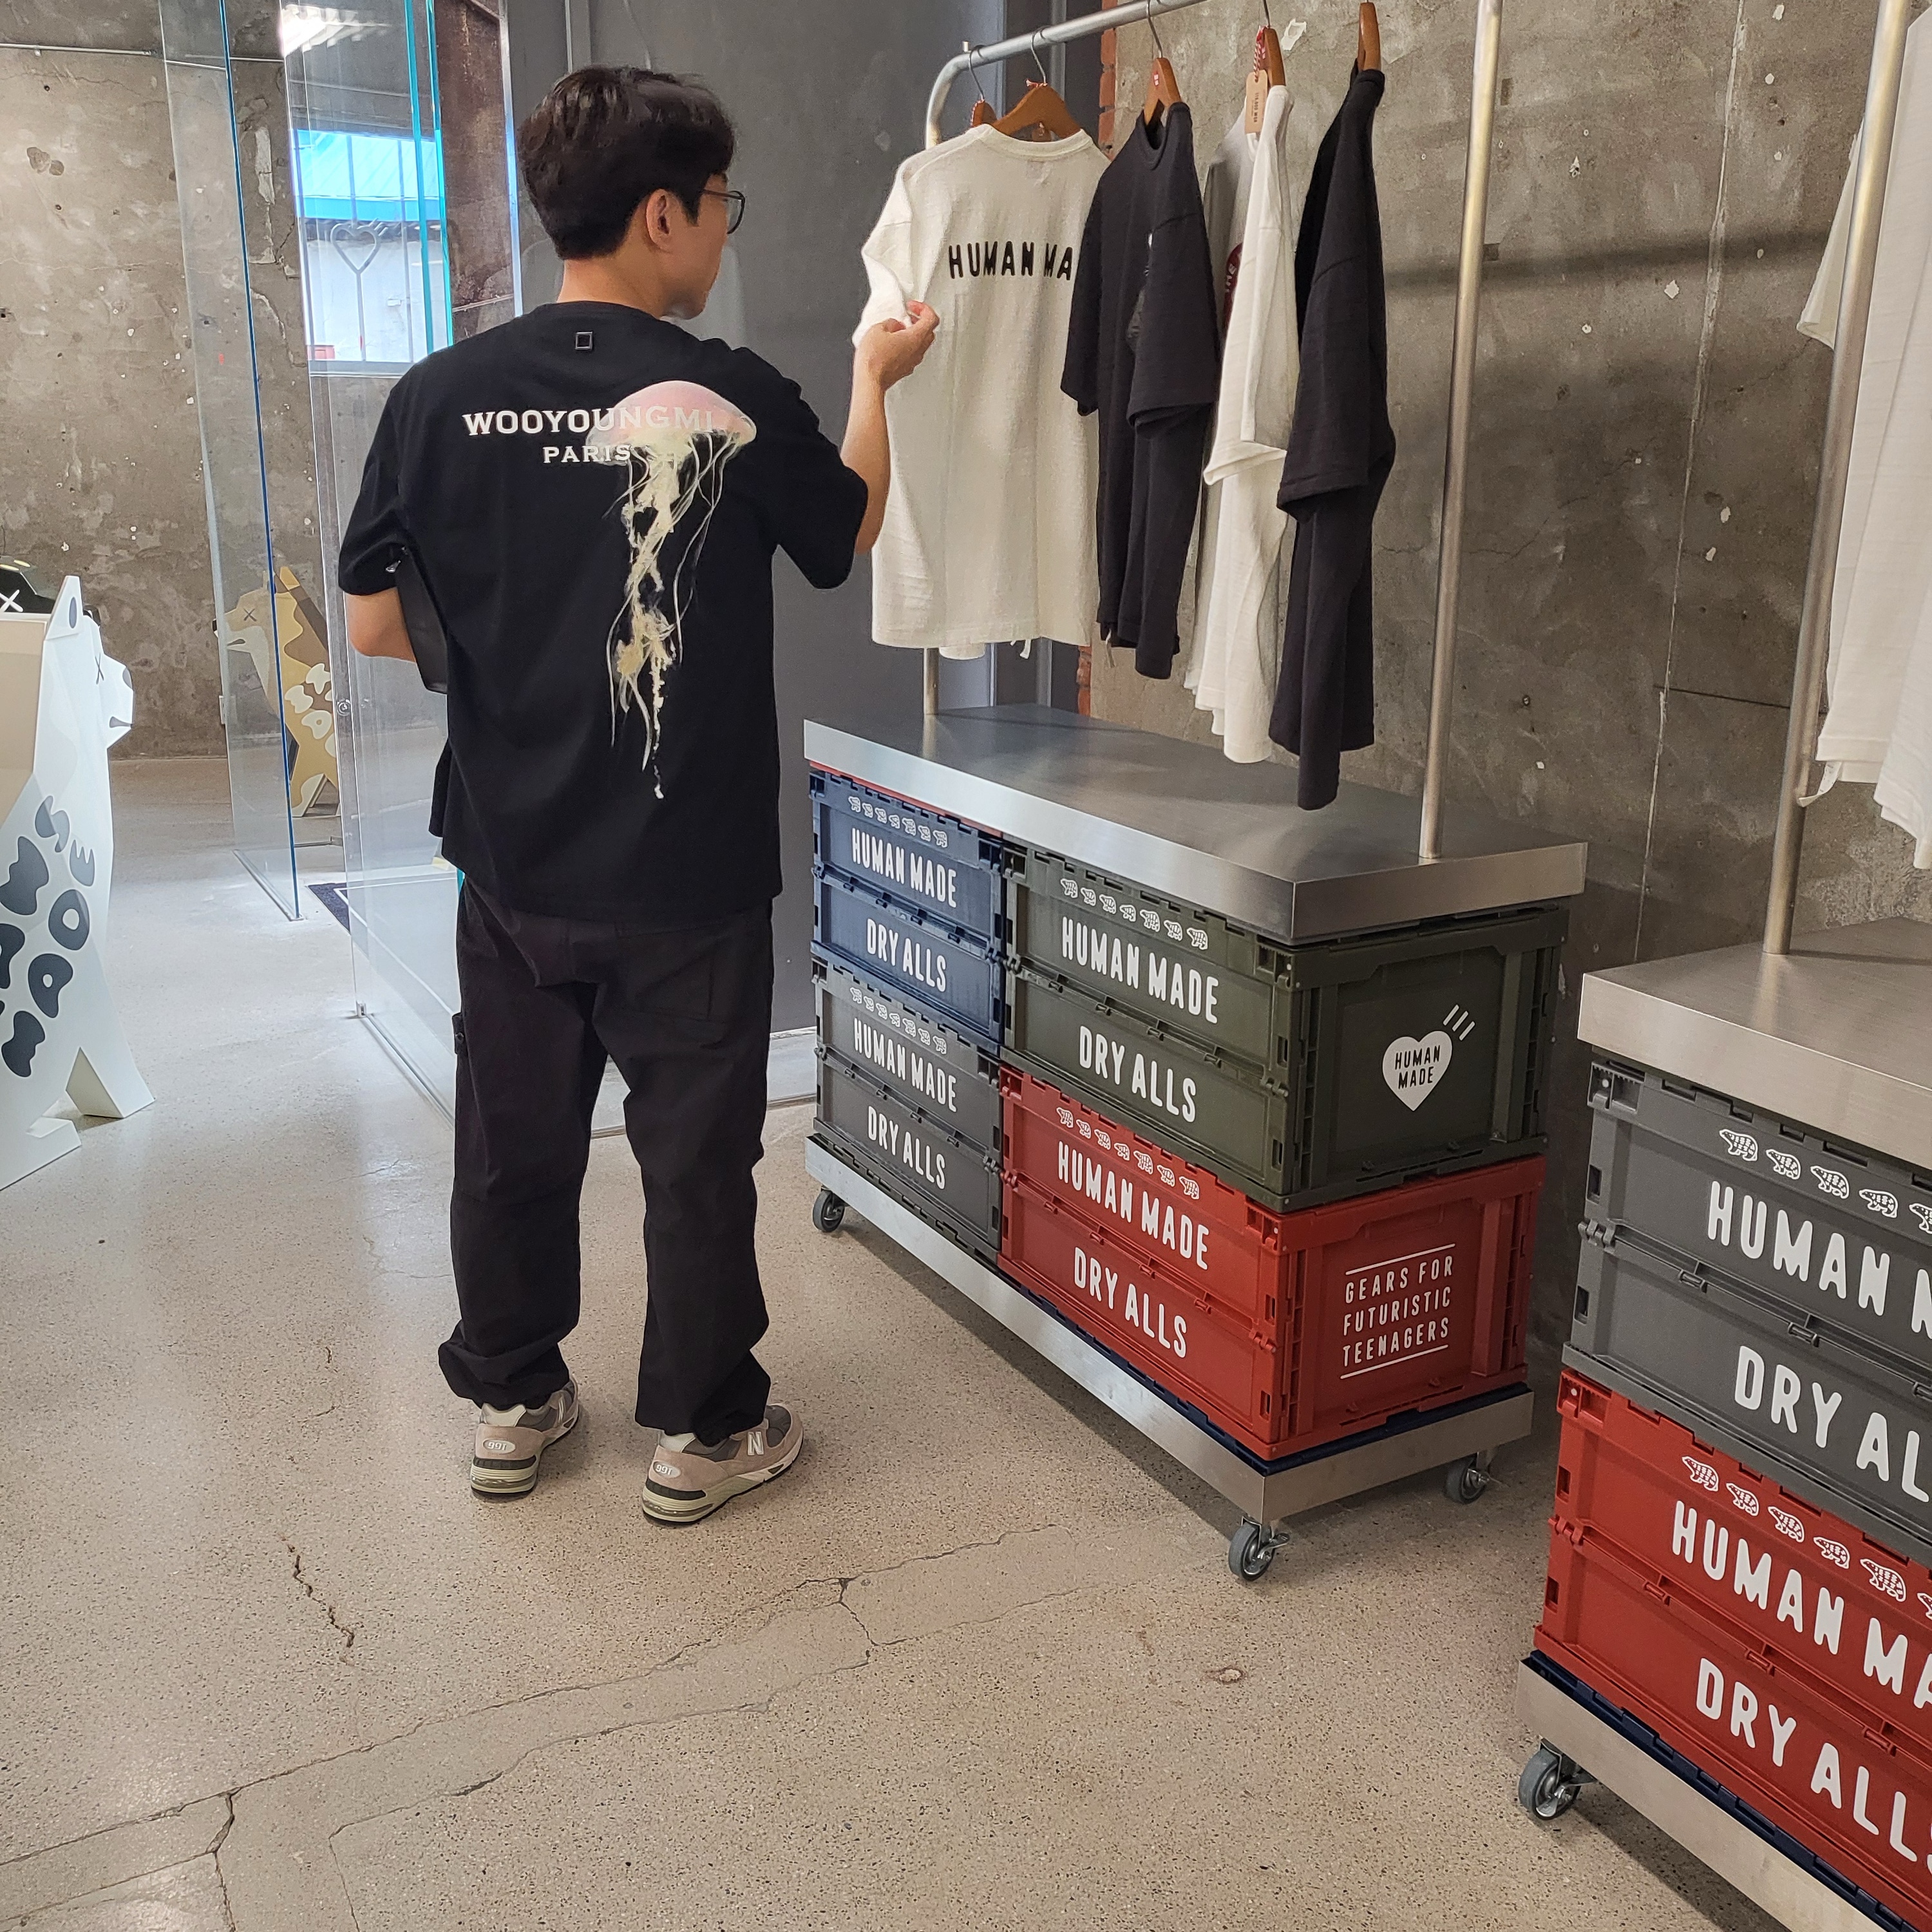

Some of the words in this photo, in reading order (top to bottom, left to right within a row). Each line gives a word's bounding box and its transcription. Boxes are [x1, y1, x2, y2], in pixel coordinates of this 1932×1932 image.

[949, 241, 1034, 279] HUMAN
[462, 405, 714, 436] WOOYOUNGMI
[543, 444, 631, 464] PARIS
[852, 828, 904, 884] HUMAN
[911, 853, 957, 908] MADE
[867, 918, 898, 967] DRY
[903, 938, 946, 992] ALLS
[1063, 917, 1139, 989] HUMAN
[1149, 953, 1218, 1024] MADE
[853, 1018, 905, 1081] HUMAN
[911, 1052, 957, 1112] MADE
[1080, 1026, 1125, 1085] DRY
[1132, 1054, 1196, 1122] ALLS
[1395, 1045, 1441, 1070] HUMAN
[1398, 1066, 1434, 1090] MADE
[868, 1105, 899, 1156] DRY
[903, 1131, 945, 1189] ALLS
[1059, 1141, 1133, 1223] HUMAN
[1142, 1191, 1209, 1270] MADE
[1345, 1267, 1409, 1304] GEARS
[1419, 1256, 1453, 1284] FOR
[1708, 1180, 1890, 1316] HUMAN
[1075, 1247, 1118, 1309] DRY
[1125, 1283, 1187, 1358] ALLS
[1343, 1287, 1450, 1336] FUTURISTIC
[1343, 1317, 1449, 1367] TEENAGERS
[488, 1441, 507, 1451] 991
[747, 1431, 764, 1456] N
[1735, 1345, 1842, 1448] DRY
[1856, 1412, 1929, 1501] AL
[655, 1464, 673, 1475] 991
[1672, 1500, 1844, 1655] HUMAN
[1696, 1658, 1797, 1767] DRY
[1810, 1742, 1932, 1876] ALL
